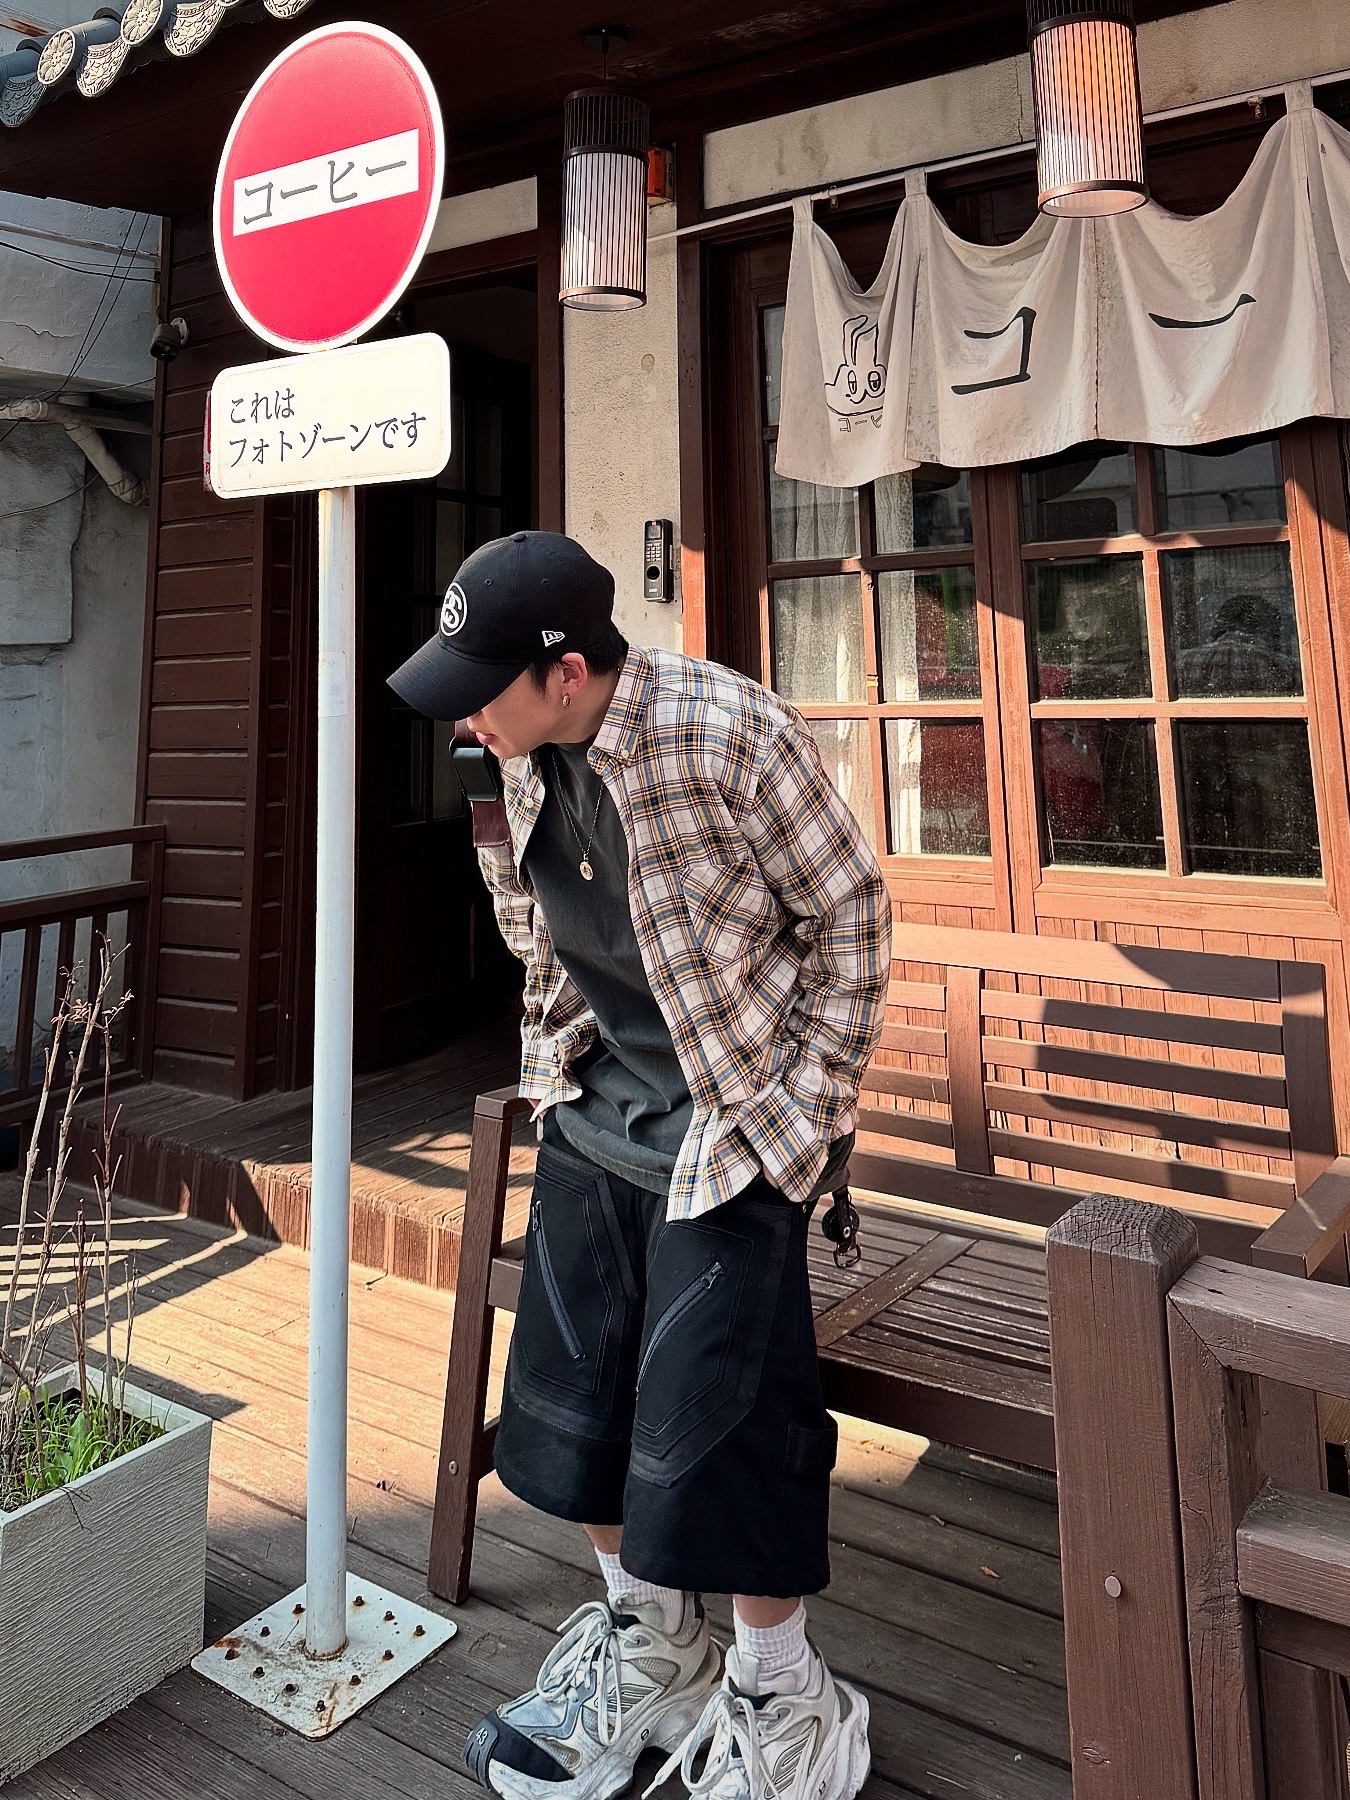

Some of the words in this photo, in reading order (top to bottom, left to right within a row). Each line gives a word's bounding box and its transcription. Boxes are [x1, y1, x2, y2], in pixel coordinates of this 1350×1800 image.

[243, 160, 407, 225] コーヒー
[230, 388, 295, 424] これは
[229, 412, 427, 468] フォトゾーンです
